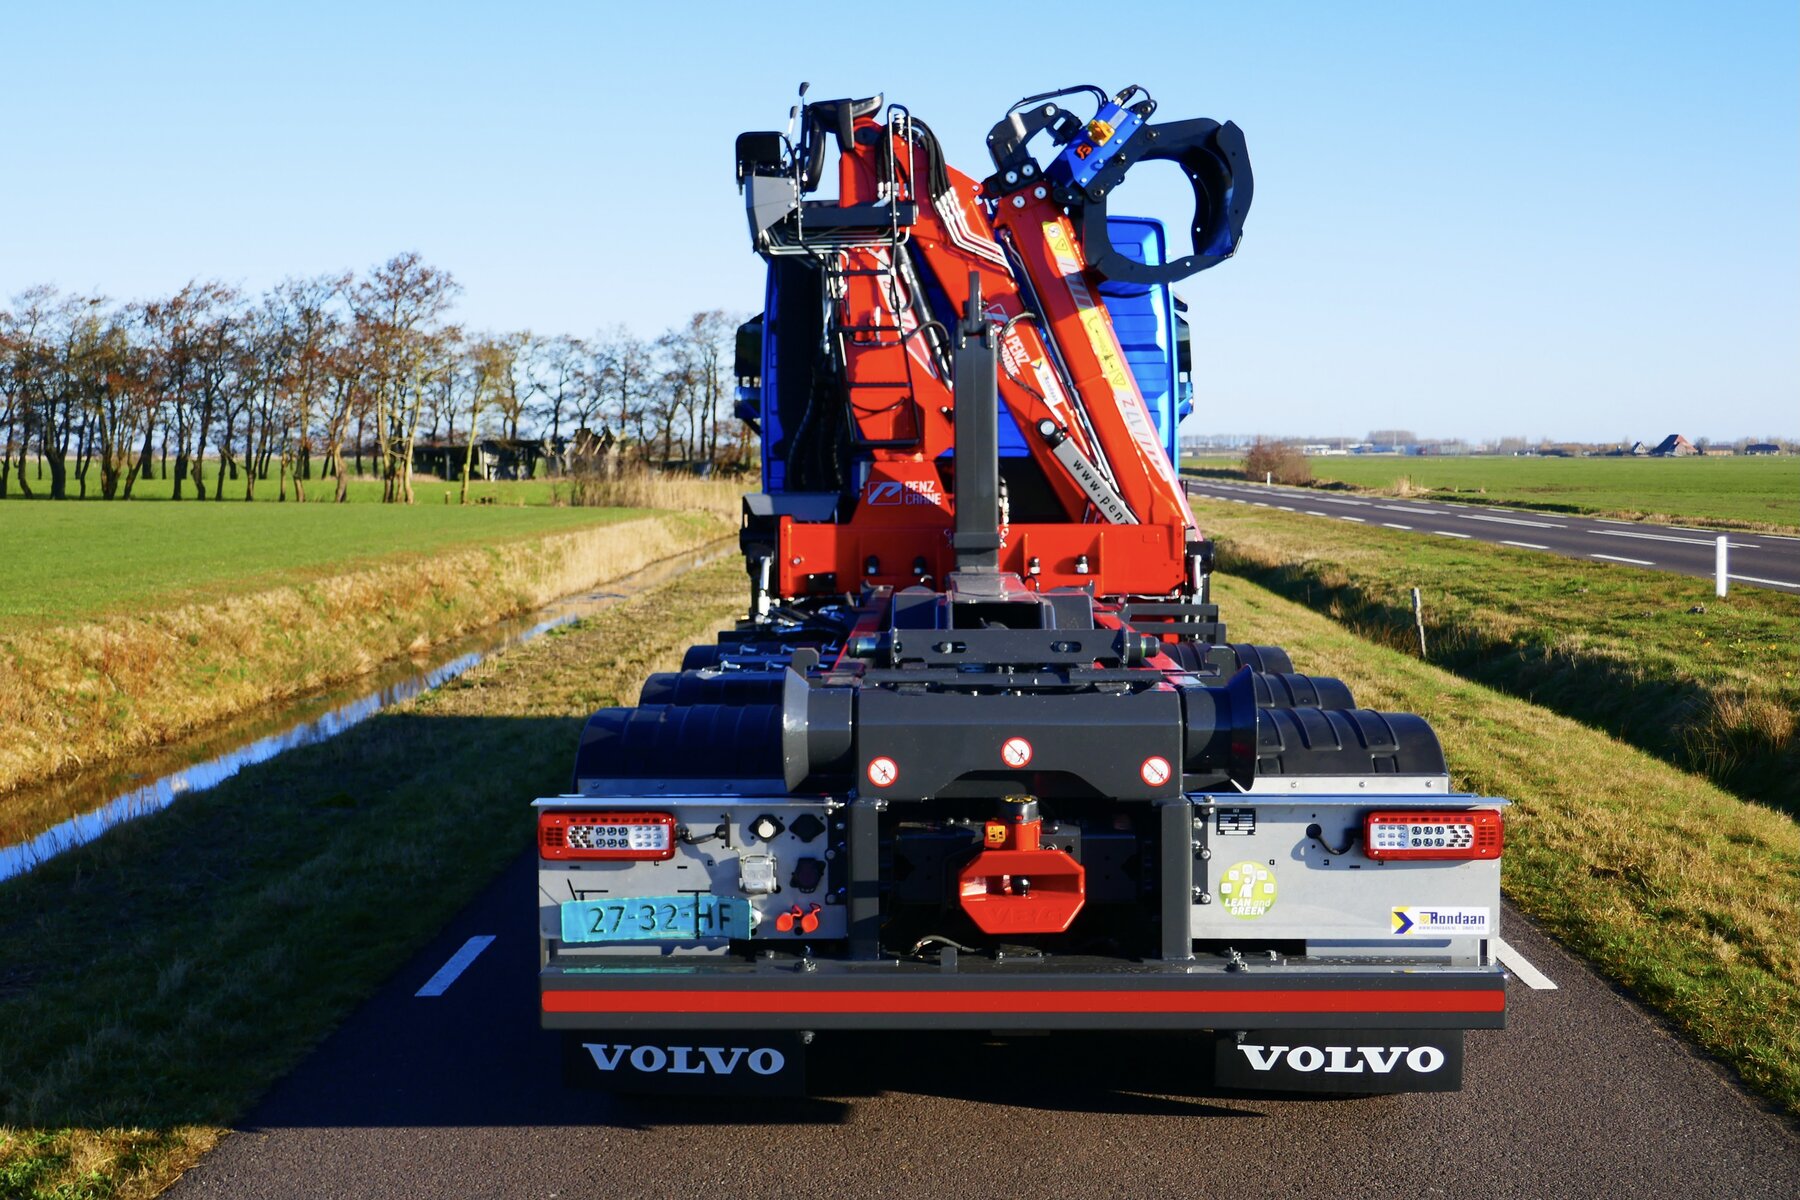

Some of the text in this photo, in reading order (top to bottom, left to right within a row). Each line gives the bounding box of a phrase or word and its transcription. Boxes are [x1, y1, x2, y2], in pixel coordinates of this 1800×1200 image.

[1005, 335, 1031, 367] PENZ
[905, 481, 935, 493] PENZ
[905, 493, 942, 506] CRANE
[1224, 898, 1271, 907] LEAN and
[1231, 906, 1265, 916] GREEN
[589, 902, 732, 934] 27-32-HF
[1420, 912, 1485, 925] Rondaan
[582, 1043, 785, 1075] VOLVO
[1237, 1045, 1445, 1073] VOLVO
